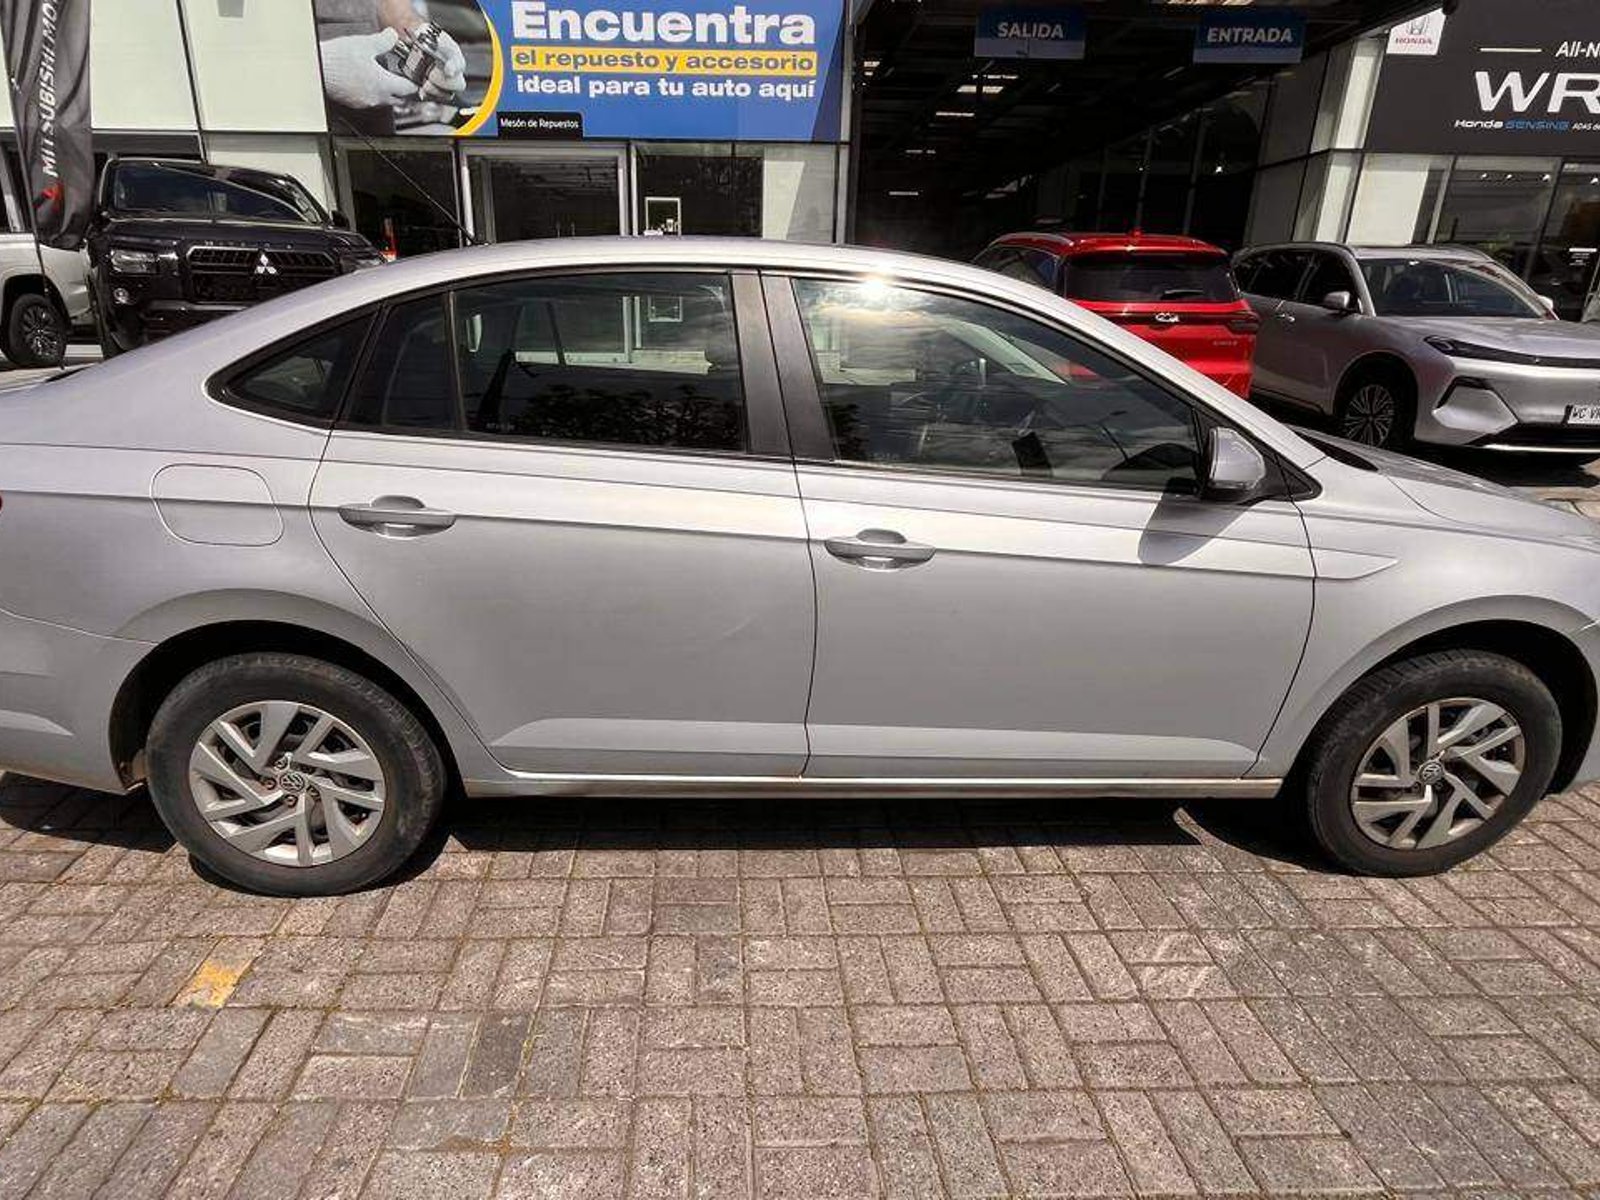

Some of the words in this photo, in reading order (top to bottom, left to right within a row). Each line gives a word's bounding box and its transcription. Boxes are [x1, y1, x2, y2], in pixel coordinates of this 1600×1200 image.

[511, 0, 816, 45] Encuentra
[998, 21, 1064, 39] SALIDA
[1206, 27, 1294, 43] ENTRADA
[1395, 37, 1433, 45] HONDA
[1554, 40, 1600, 58] All-N
[515, 50, 537, 66] el
[545, 50, 659, 69] repuesto
[664, 54, 679, 71] y
[686, 53, 814, 71] accesorio
[516, 74, 581, 95] ideal
[588, 80, 651, 98] para
[657, 77, 685, 97] tu
[692, 79, 752, 97] auto
[758, 79, 816, 101] aquí
[500, 117, 527, 129] Mesón
[527, 118, 539, 128] de
[539, 118, 580, 130] Repuestos
[1454, 119, 1503, 129] Honda
[1505, 120, 1569, 131] SENSING
